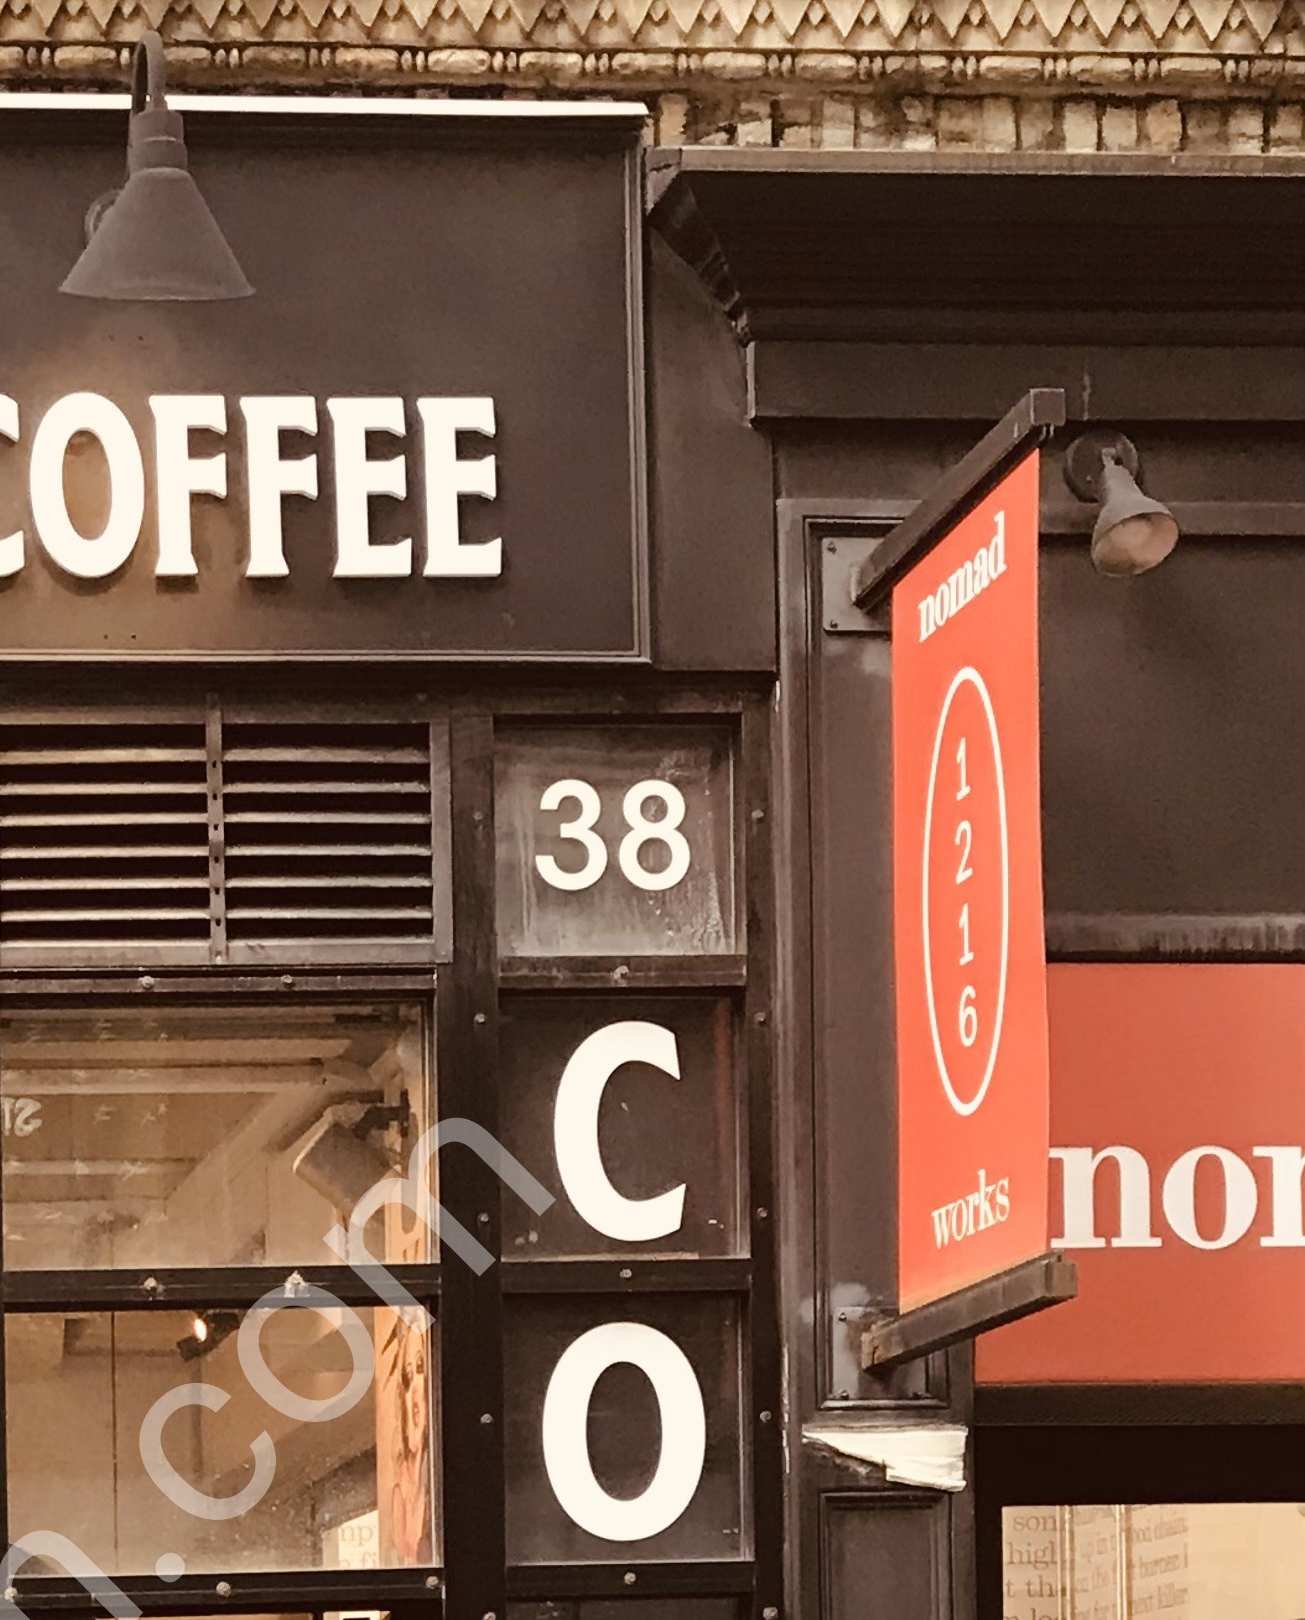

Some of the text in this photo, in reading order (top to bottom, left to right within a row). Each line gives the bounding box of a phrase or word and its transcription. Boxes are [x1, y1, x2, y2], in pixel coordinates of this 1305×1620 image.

[918, 510, 1007, 643] nomad
[535, 779, 690, 891] 38
[931, 1169, 1010, 1250] works
